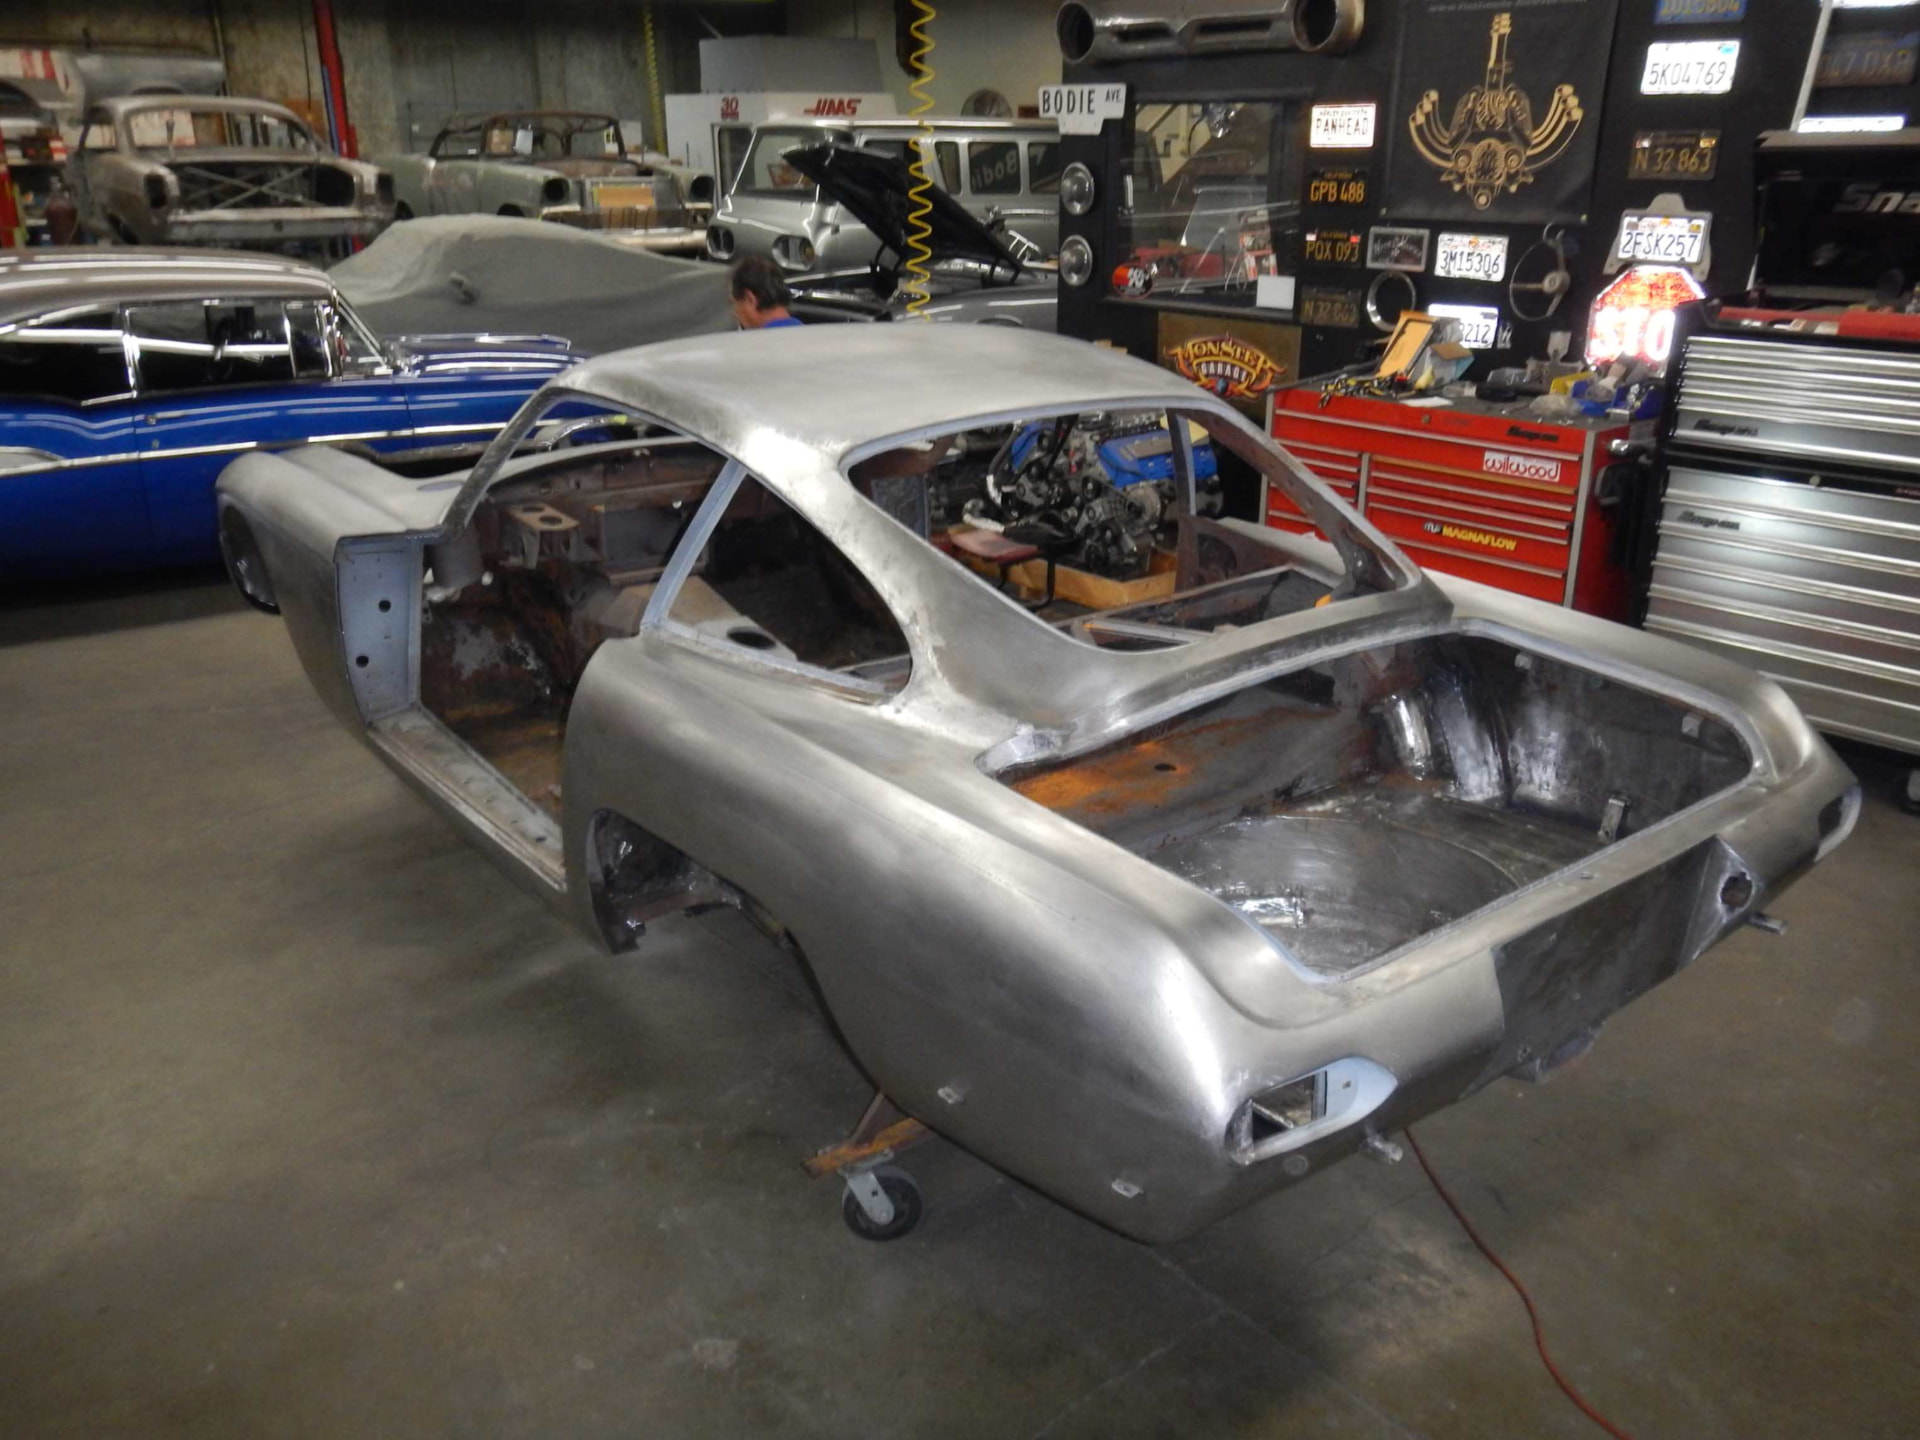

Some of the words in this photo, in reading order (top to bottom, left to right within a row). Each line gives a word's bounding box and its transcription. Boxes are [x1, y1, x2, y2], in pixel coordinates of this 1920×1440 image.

[1649, 61, 1727, 86] 5K04769
[1042, 89, 1095, 114] BODIE
[1316, 117, 1368, 136] PANHEAD
[1310, 180, 1338, 202] GPB
[1340, 181, 1366, 203] 488
[1335, 241, 1360, 262] 093
[1621, 232, 1698, 257] 2FSK257
[1440, 250, 1501, 274] 3M15306
[1485, 455, 1559, 480] wilwood
[1442, 525, 1517, 551] MAGNAFLOW
